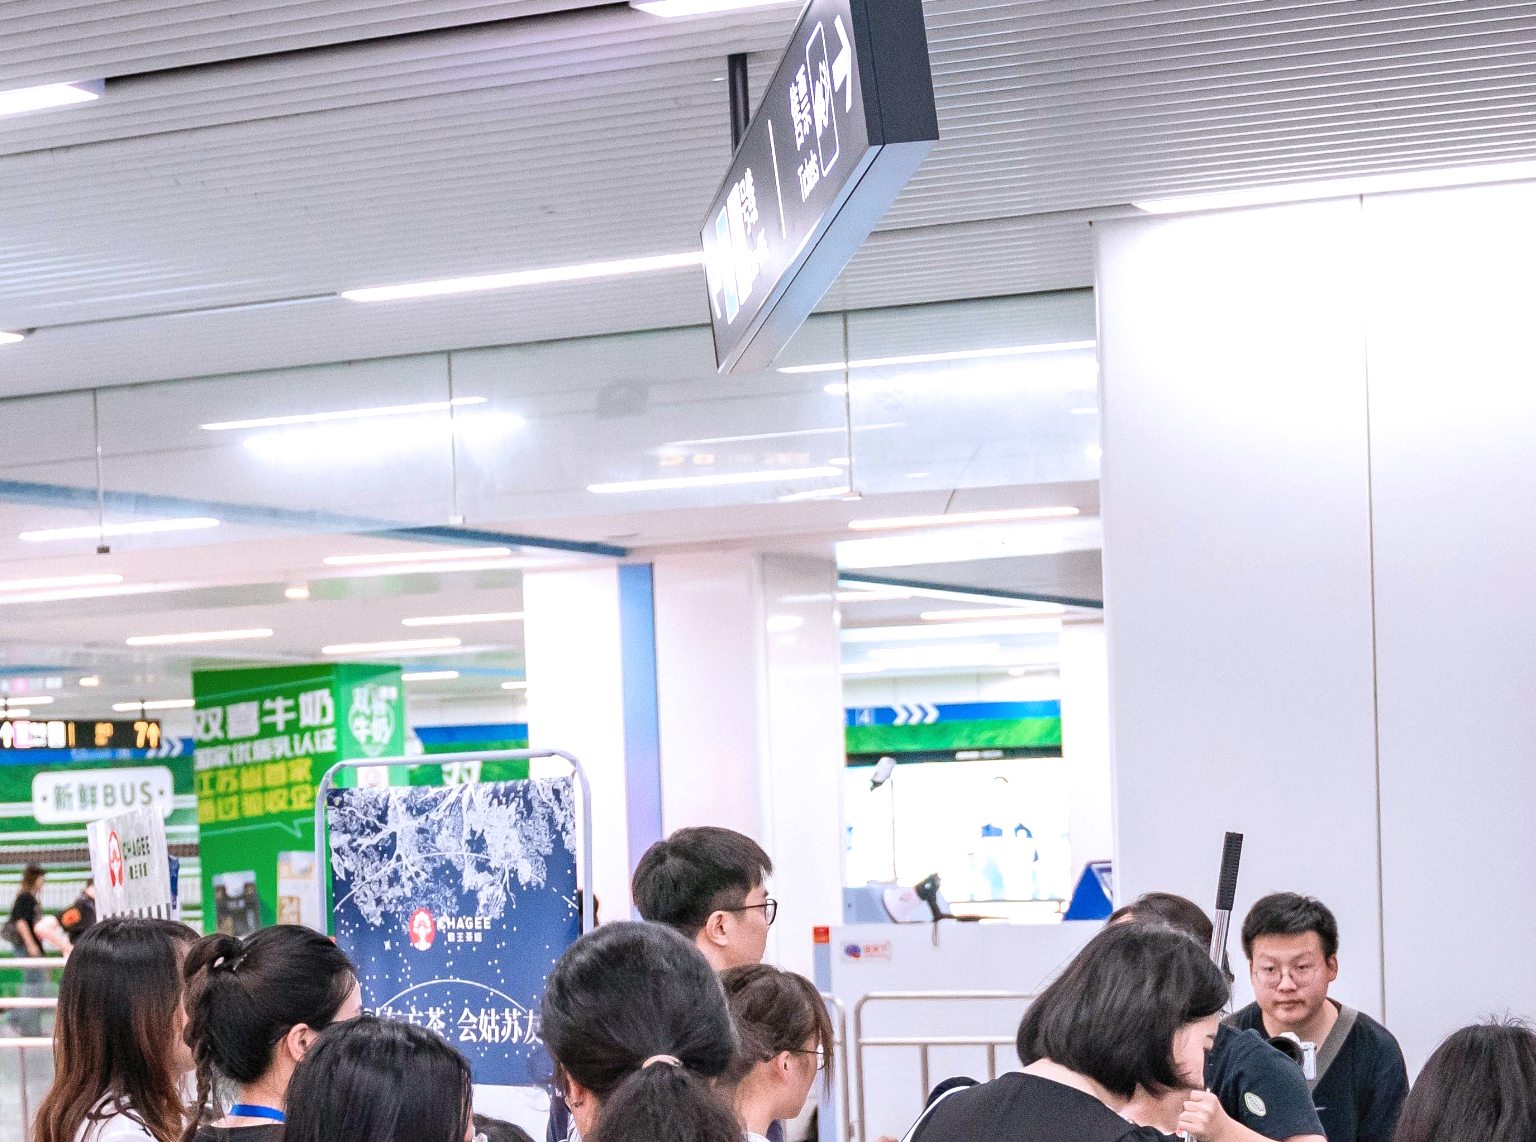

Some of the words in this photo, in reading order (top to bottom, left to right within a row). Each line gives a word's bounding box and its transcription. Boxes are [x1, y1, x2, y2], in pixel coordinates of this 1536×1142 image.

[438, 916, 492, 930] CHAGEE
[456, 1007, 545, 1045] 会姑苏友
